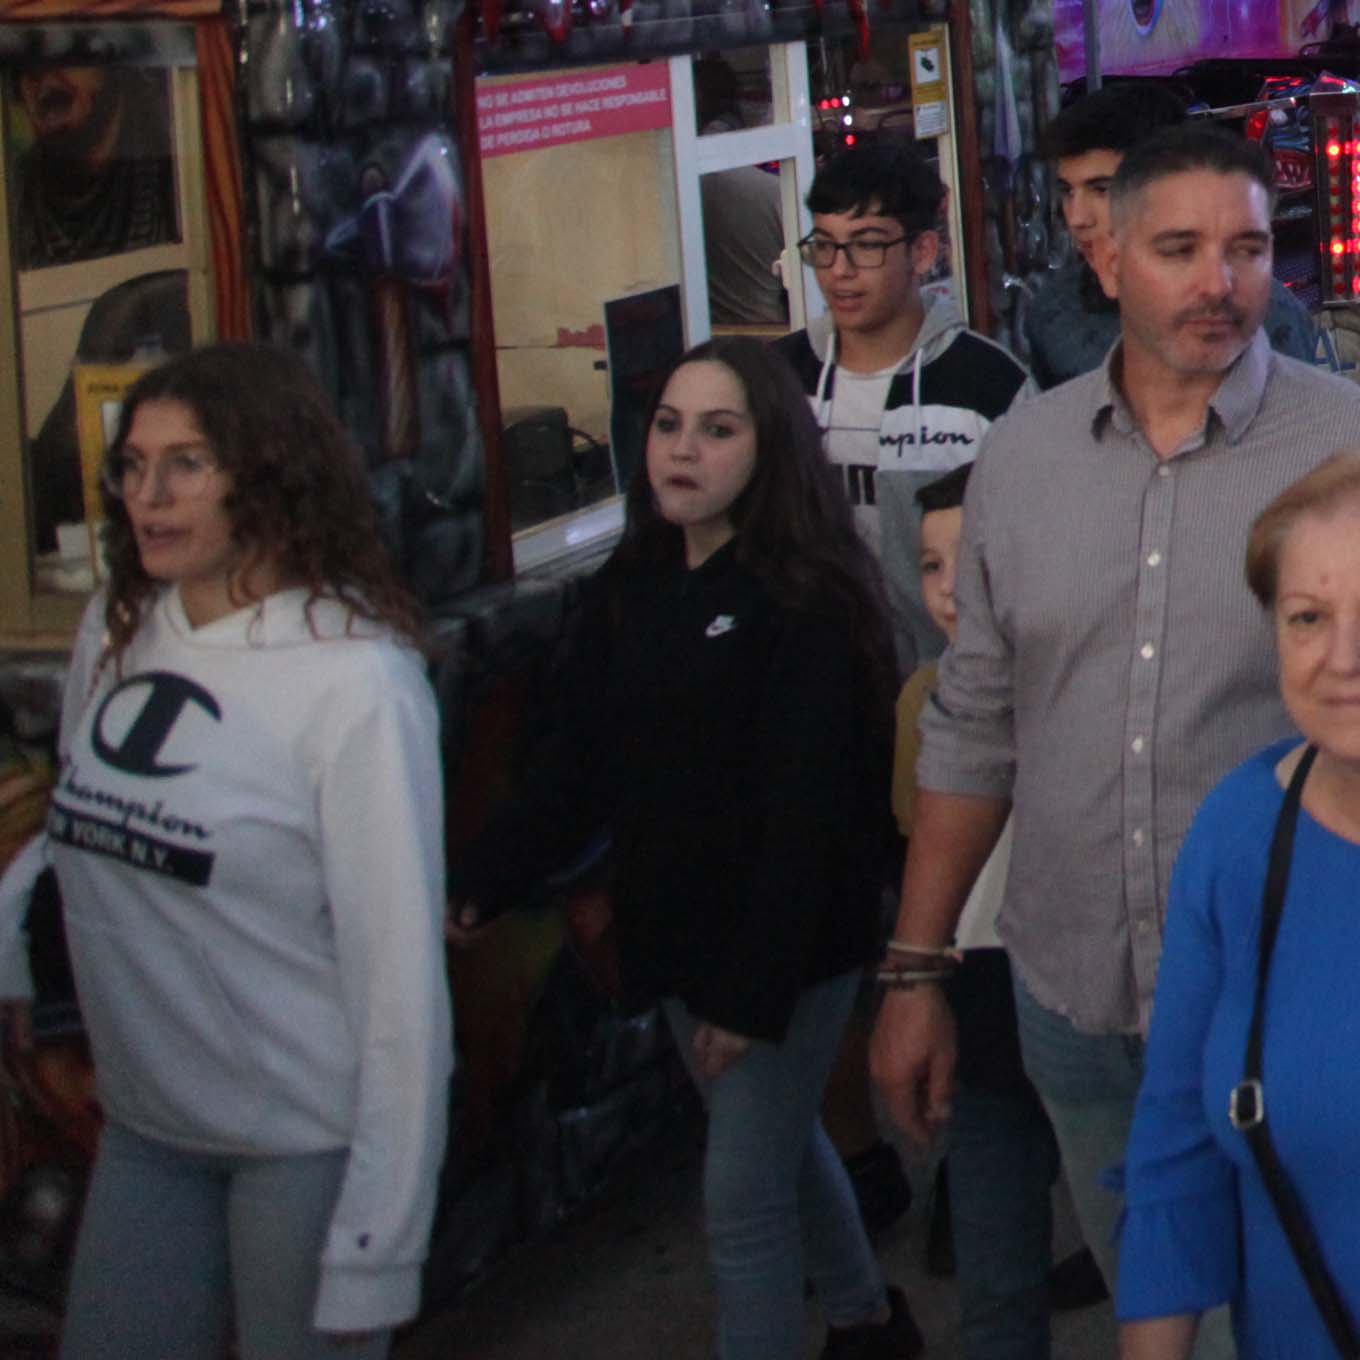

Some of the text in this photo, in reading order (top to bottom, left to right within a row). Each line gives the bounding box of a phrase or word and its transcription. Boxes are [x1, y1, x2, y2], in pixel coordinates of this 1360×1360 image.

[556, 74, 628, 99] DEVOLUCIONES
[495, 107, 543, 127] EMPRESA
[575, 97, 601, 115] HACE
[602, 88, 668, 110] RESPONSABLE
